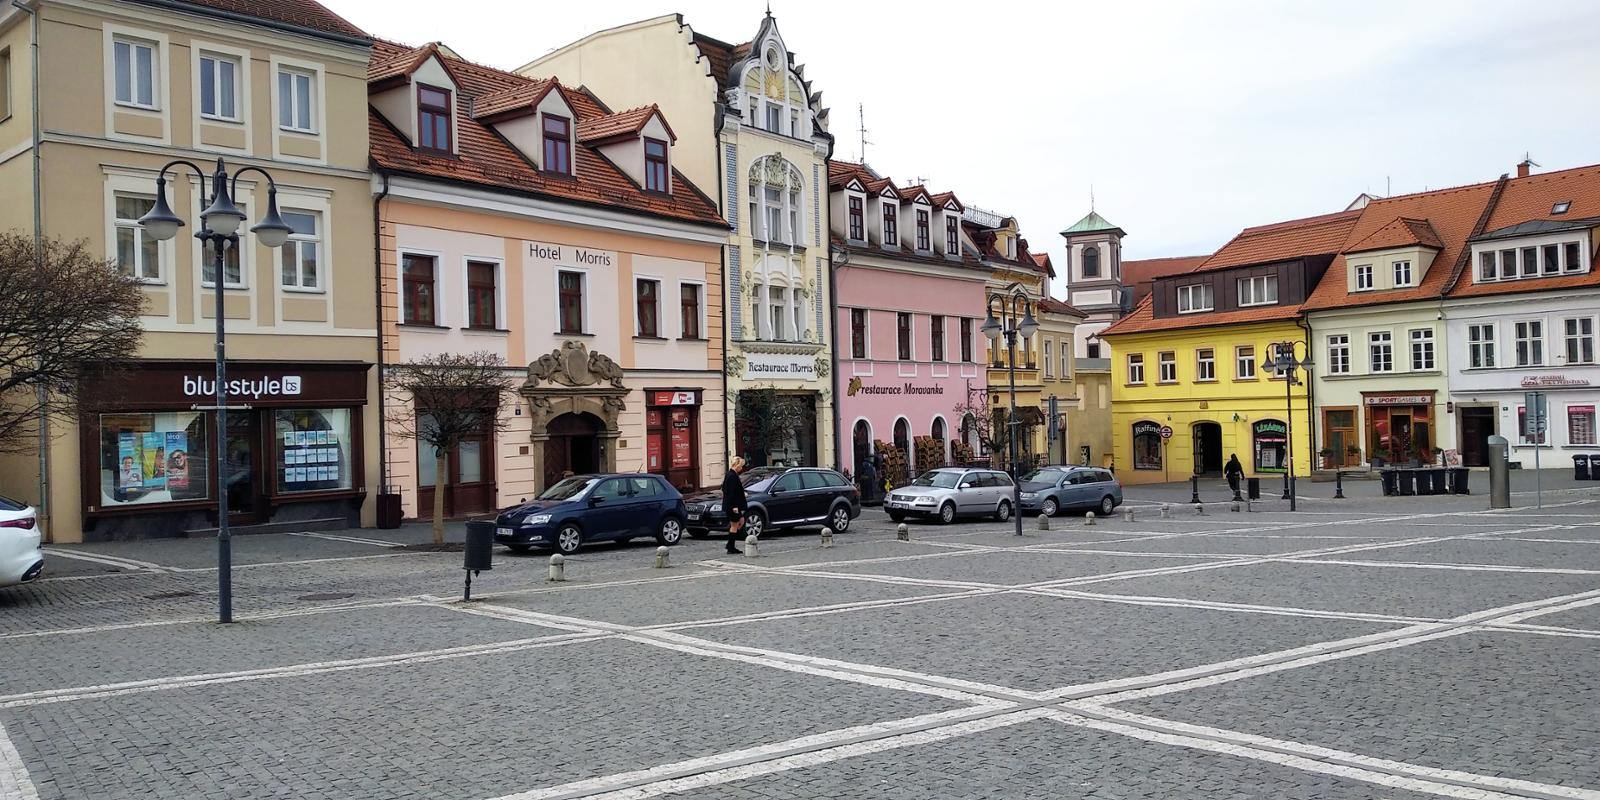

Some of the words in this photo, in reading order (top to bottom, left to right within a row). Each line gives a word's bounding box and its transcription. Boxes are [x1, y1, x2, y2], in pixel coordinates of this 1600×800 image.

[529, 243, 561, 261] Hotel
[575, 249, 611, 266] Morris
[748, 361, 789, 373] Restaurace
[790, 363, 813, 373] Morris
[861, 384, 902, 395] restaurace
[903, 382, 944, 395] Moravanka
